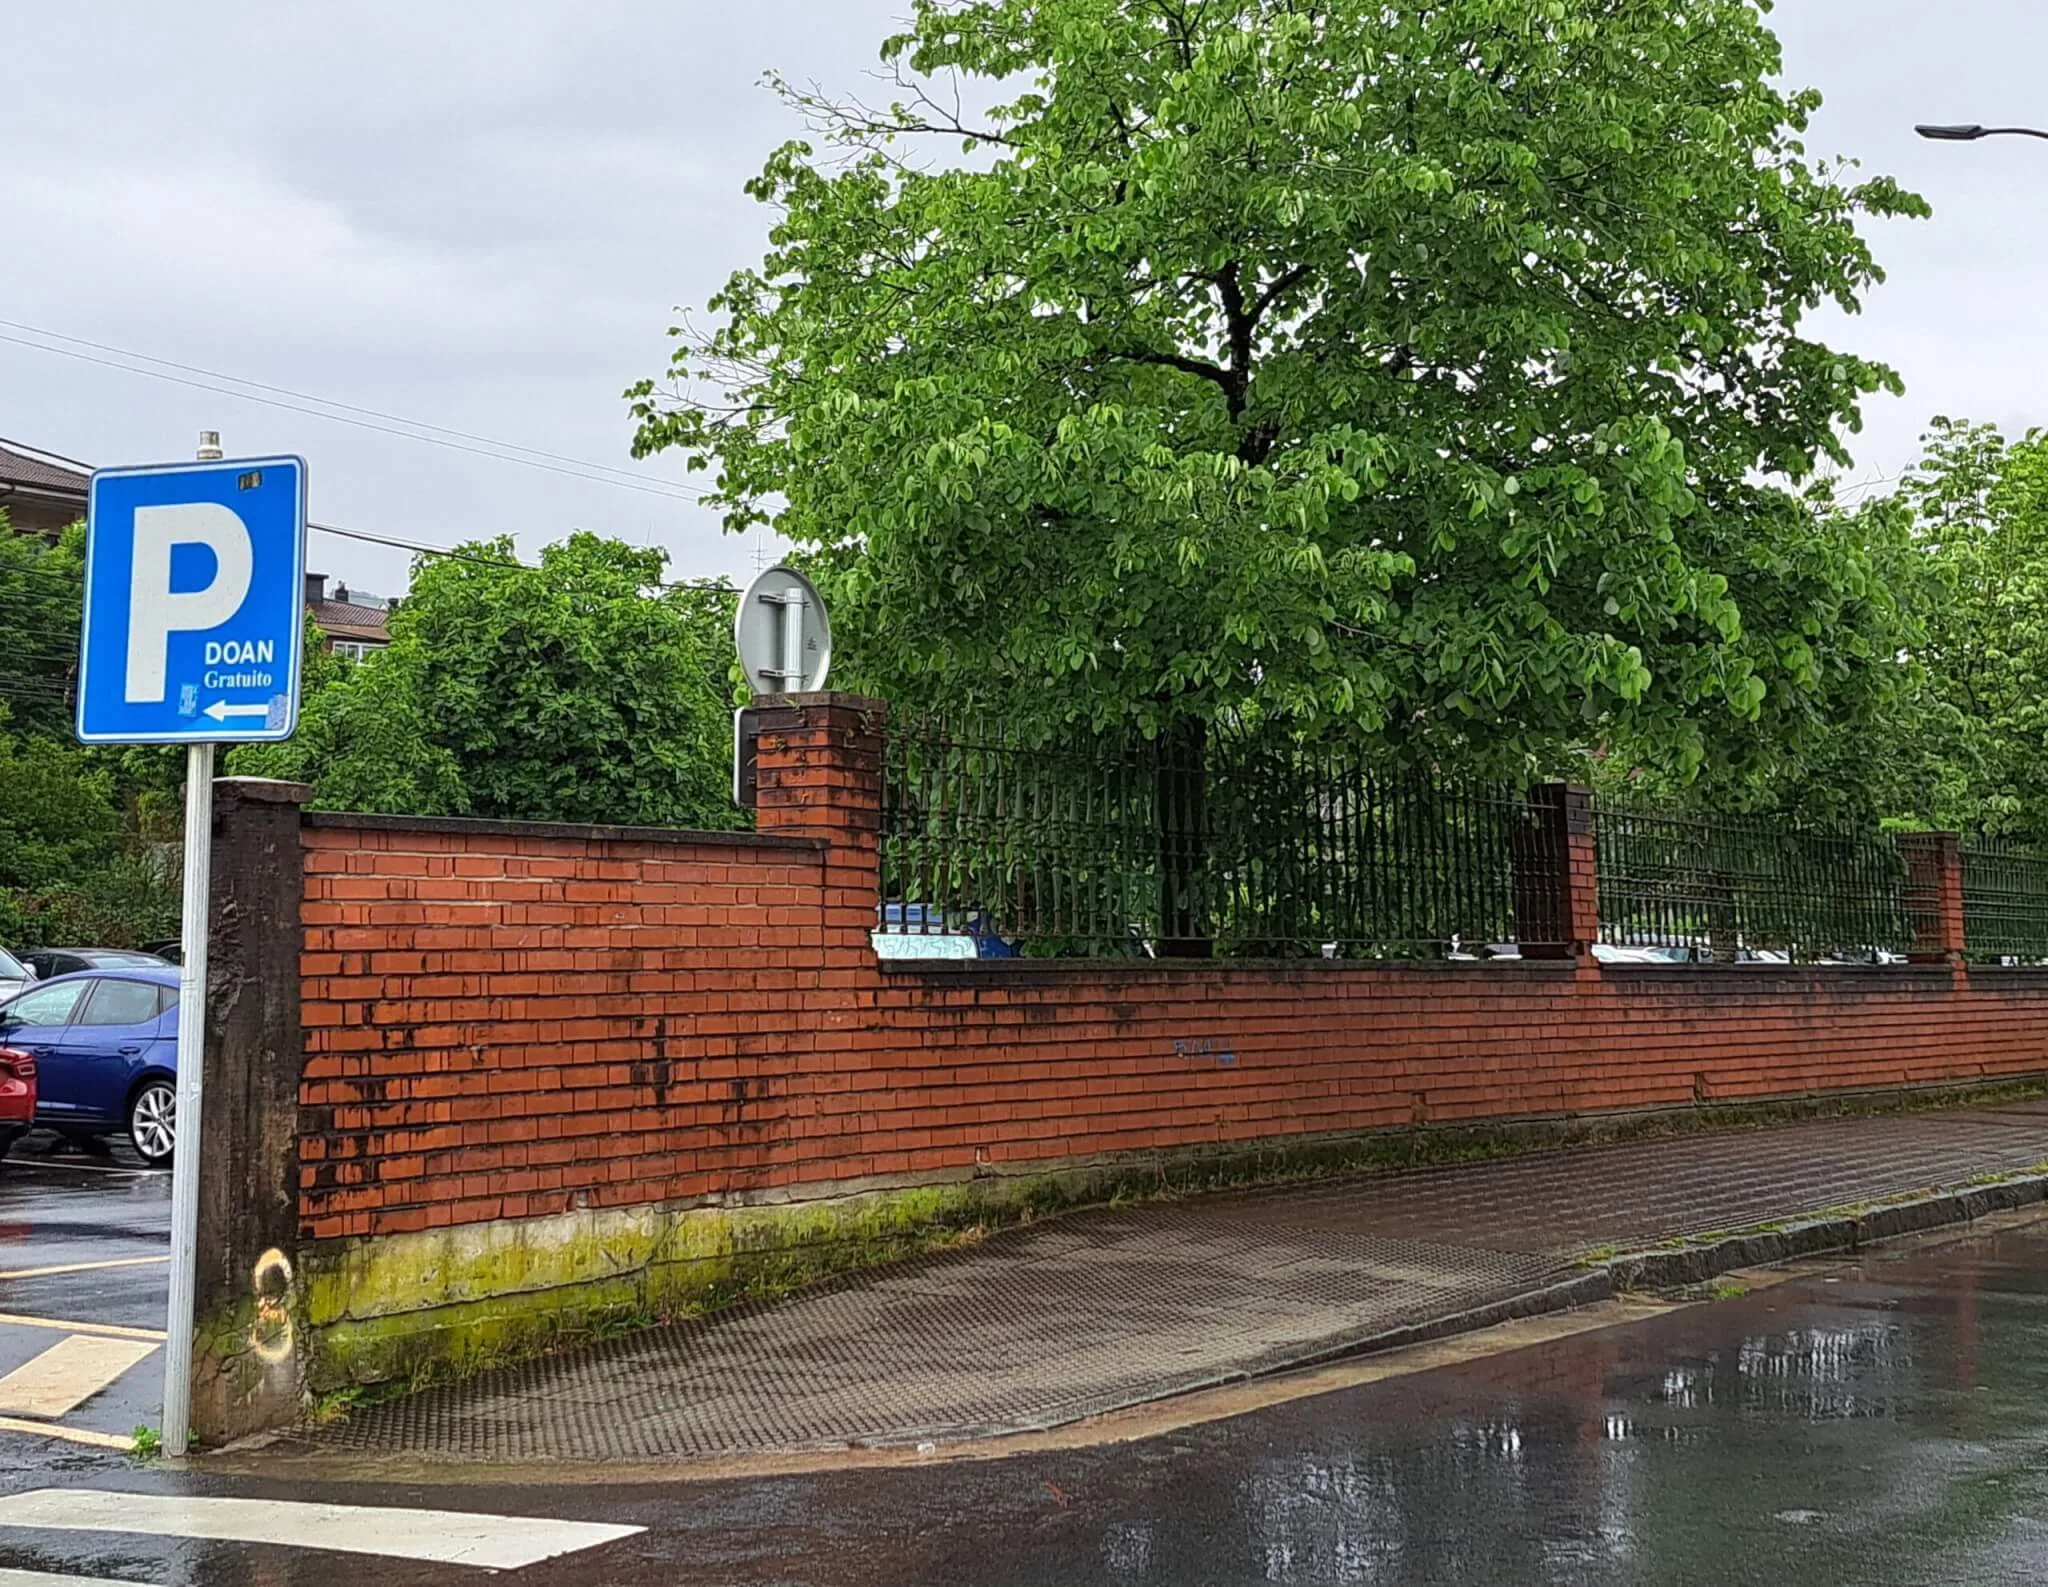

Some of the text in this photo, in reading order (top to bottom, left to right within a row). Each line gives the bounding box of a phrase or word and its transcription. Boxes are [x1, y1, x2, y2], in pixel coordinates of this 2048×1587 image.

[124, 502, 253, 703] P
[204, 639, 274, 665] DOAN
[203, 669, 272, 689] Gratuito
